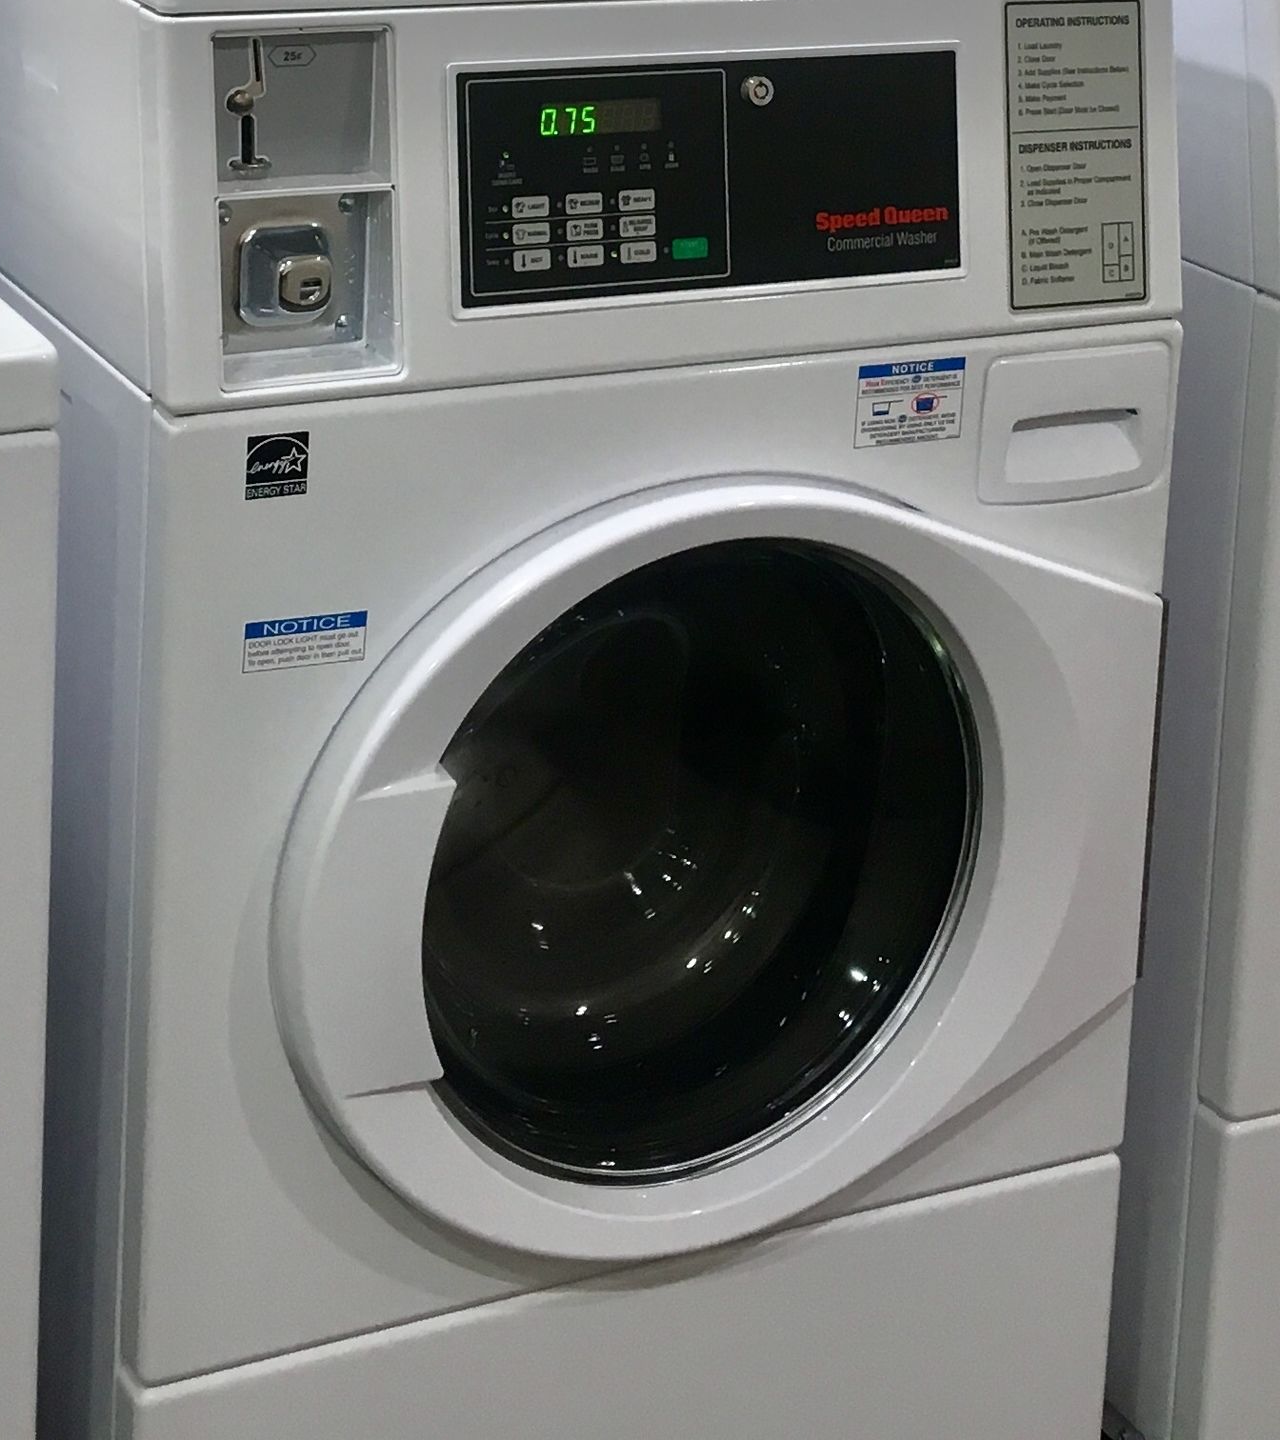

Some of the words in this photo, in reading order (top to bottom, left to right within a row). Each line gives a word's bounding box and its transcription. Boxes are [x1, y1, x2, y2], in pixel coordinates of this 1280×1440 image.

[1016, 17, 1065, 28] OPERATING
[1067, 15, 1130, 26] INSTRUCTIONS
[541, 107, 595, 135] 0.75
[1019, 142, 1067, 154] DISPENSER
[1070, 139, 1132, 152] INSTRUCTIONS
[816, 208, 880, 233] Speed
[884, 207, 948, 224] Queen
[828, 233, 893, 252] Commercial
[897, 231, 937, 246] Washer
[892, 362, 934, 374] NOTICE
[247, 486, 281, 498] ENERGY
[283, 483, 306, 494] STAR
[263, 615, 351, 635] NOTICE
[273, 638, 294, 646] LOCK
[295, 635, 317, 643] LIGHT
